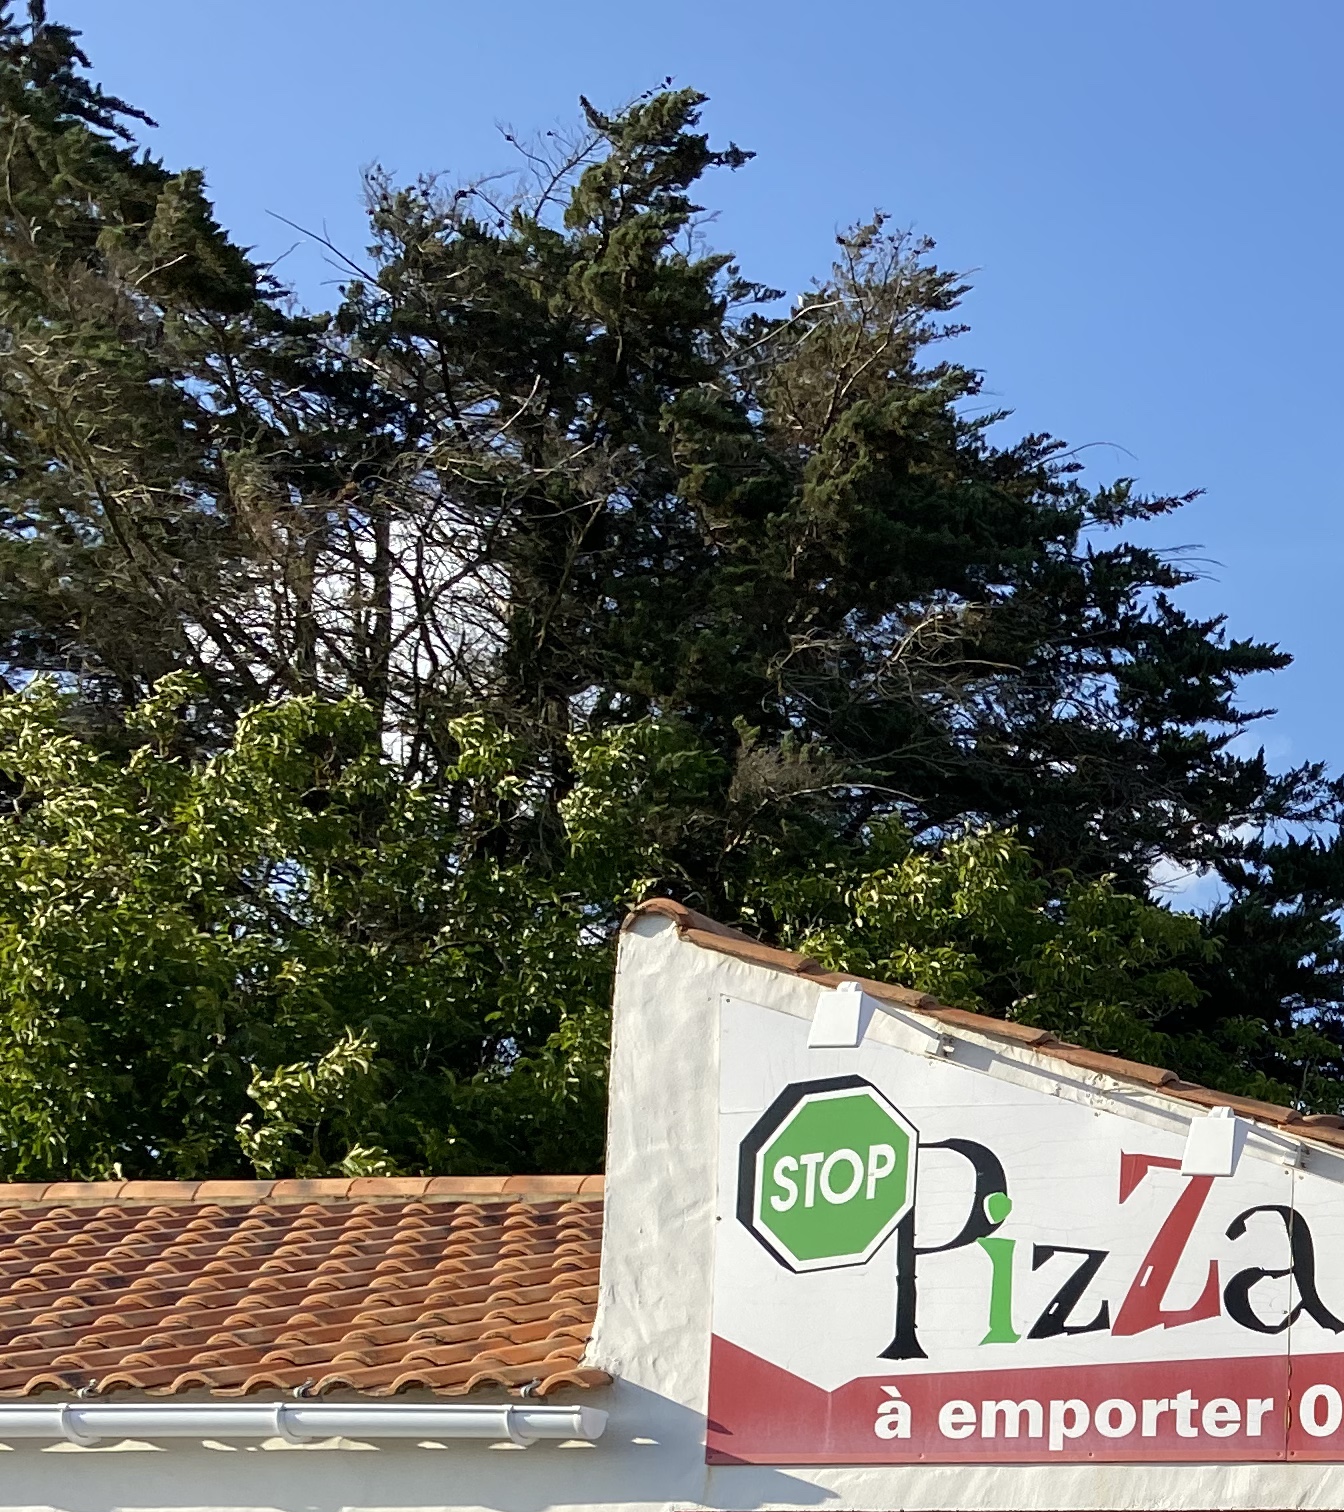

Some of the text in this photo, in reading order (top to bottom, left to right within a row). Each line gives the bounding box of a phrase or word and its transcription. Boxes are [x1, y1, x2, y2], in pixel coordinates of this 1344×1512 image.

[769, 1143, 896, 1213] STOP
[873, 1386, 912, 1441] à
[937, 1396, 1274, 1452] emporter
